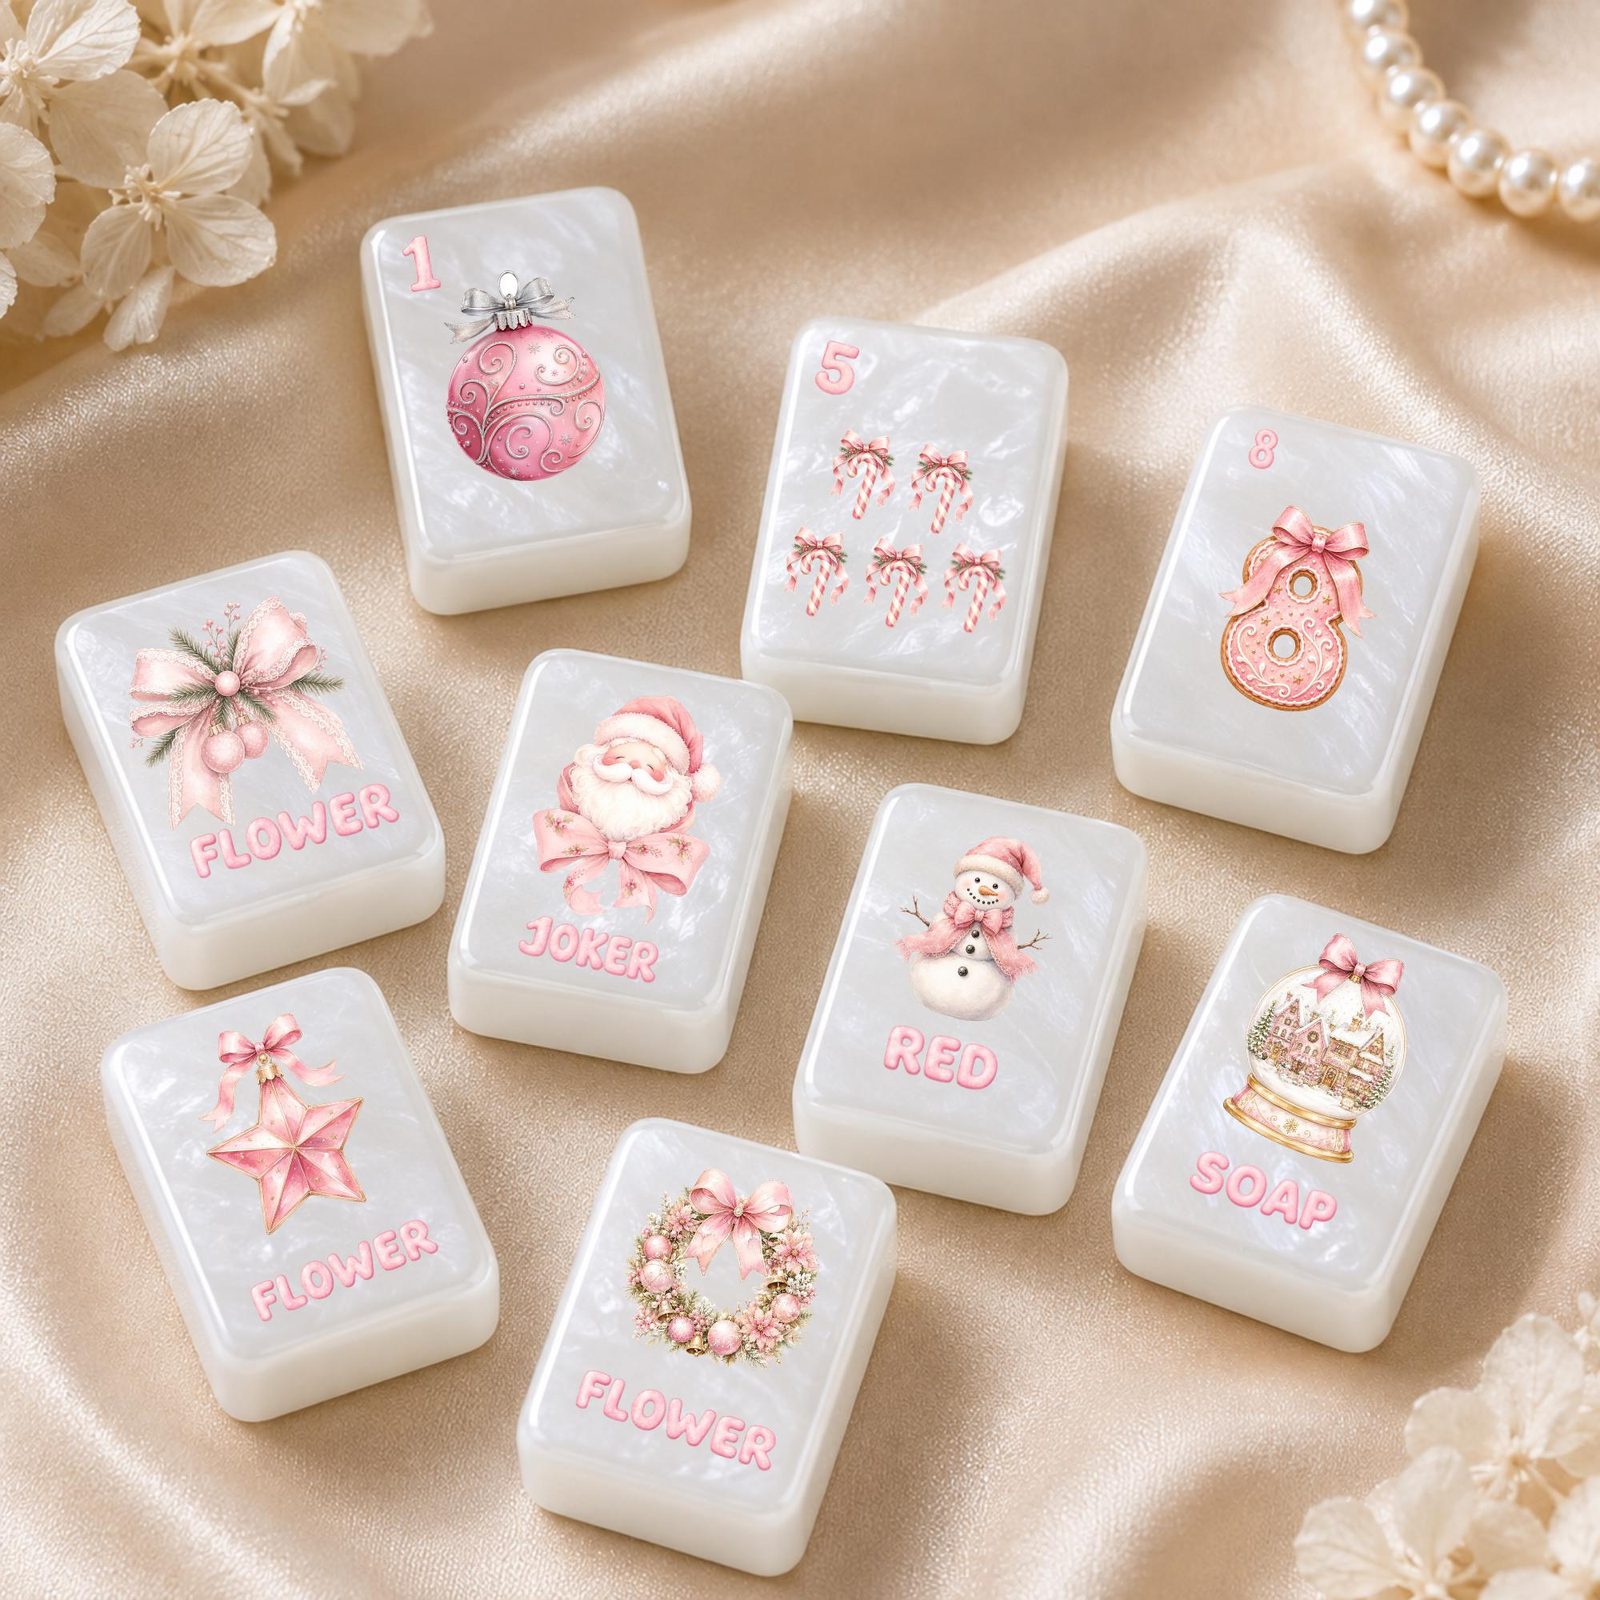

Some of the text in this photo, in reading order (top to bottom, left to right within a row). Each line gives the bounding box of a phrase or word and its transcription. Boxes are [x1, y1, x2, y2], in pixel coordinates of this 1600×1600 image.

[402, 235, 442, 293] 1
[816, 343, 860, 395] 5
[1248, 428, 1278, 469] 8
[190, 783, 399, 879] FLOWER
[519, 916, 658, 983] JOKER
[884, 1025, 998, 1090] RED
[1189, 1150, 1338, 1231] SOAP
[251, 1217, 439, 1322] FLOWER
[576, 1371, 778, 1472] FLOWER
